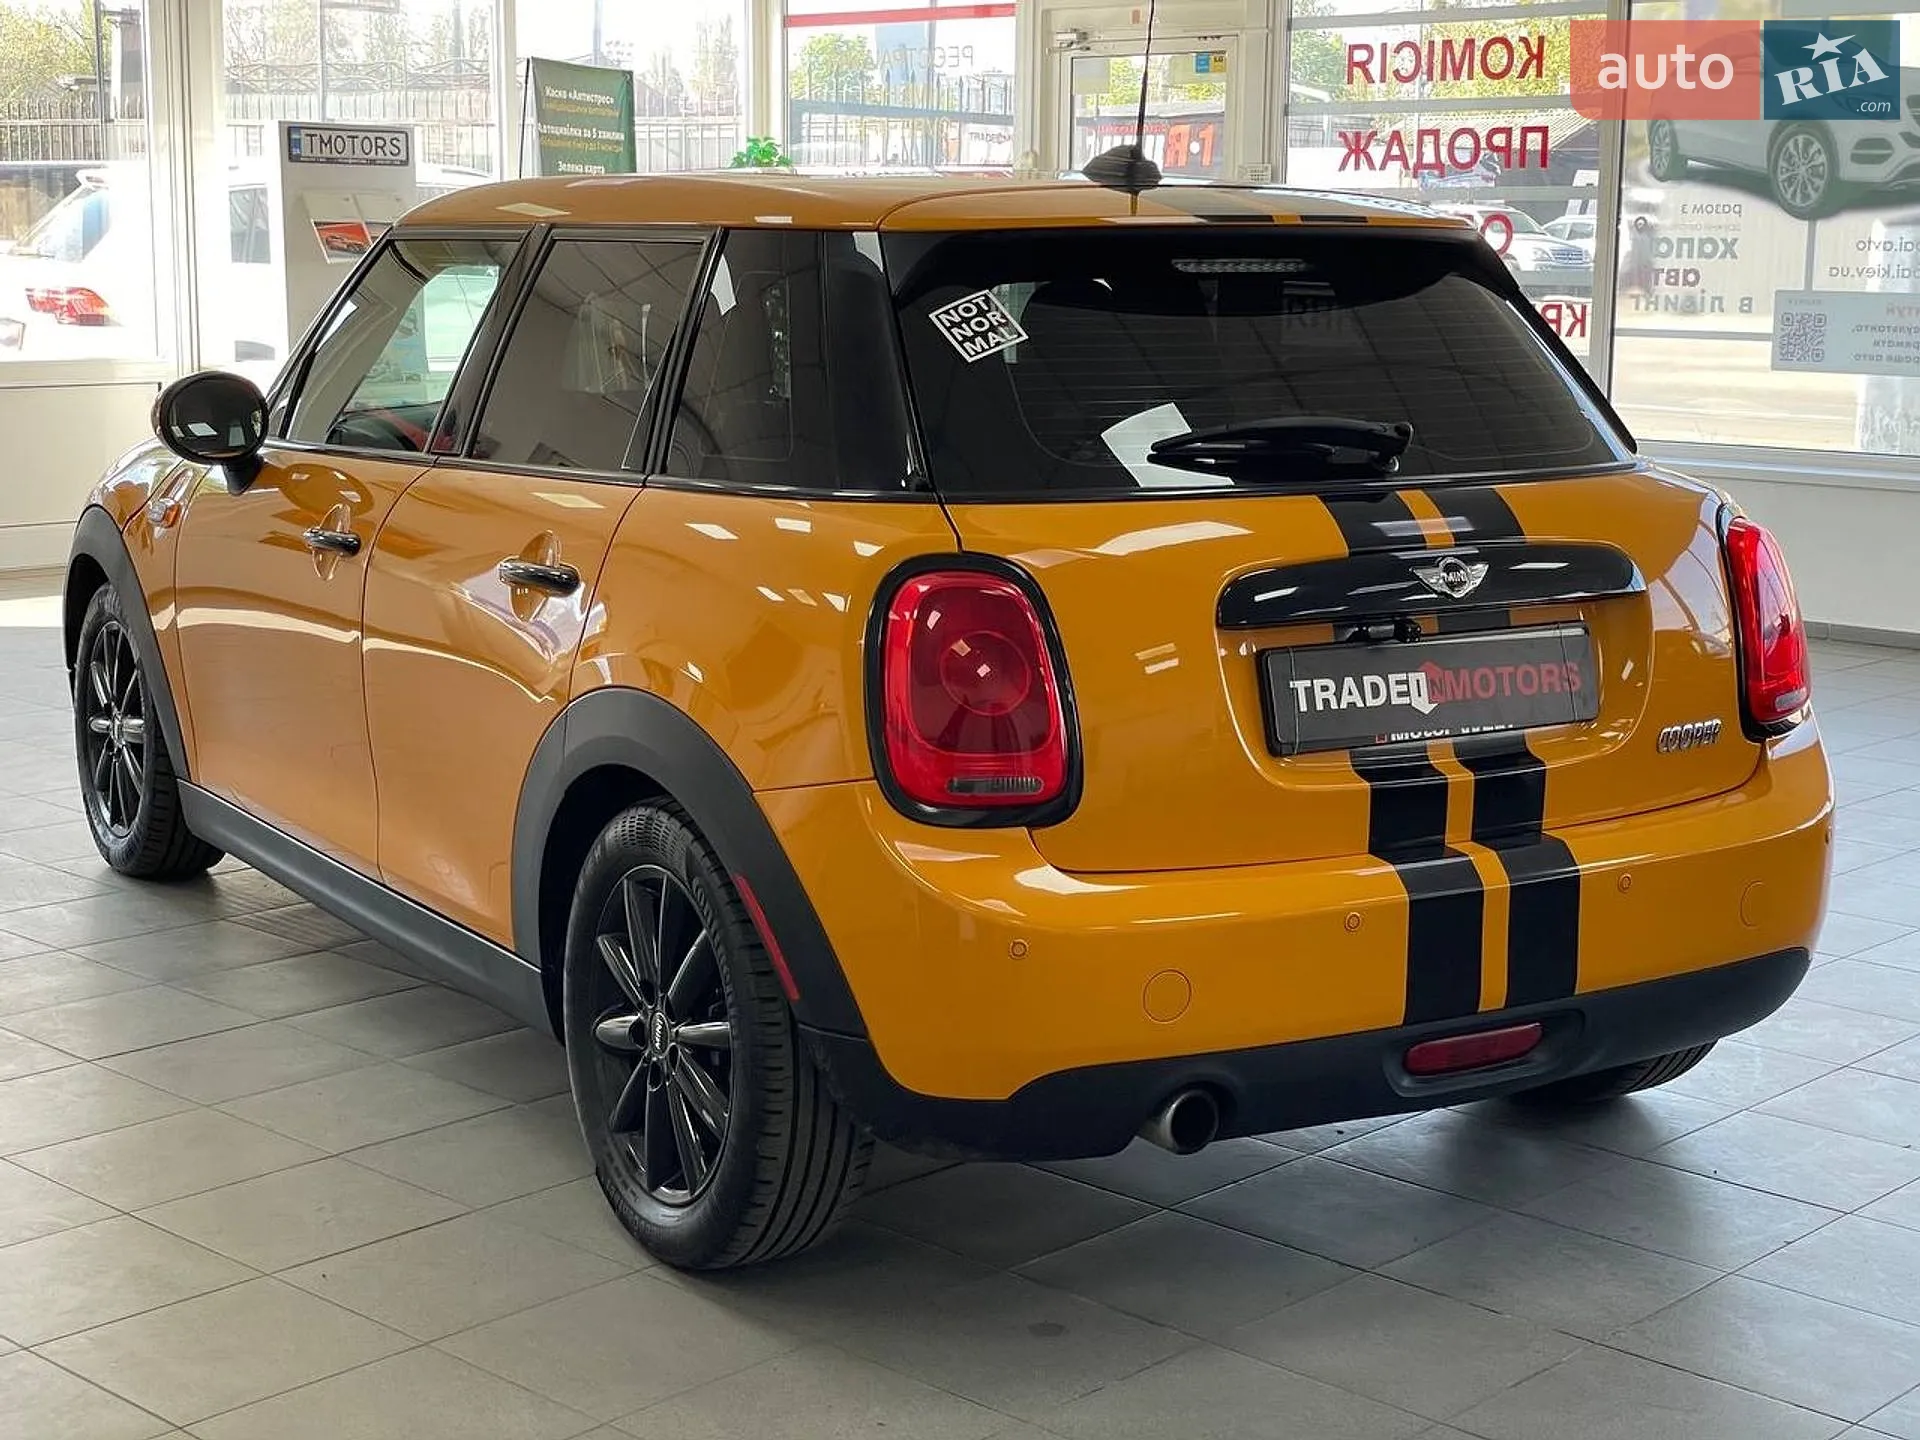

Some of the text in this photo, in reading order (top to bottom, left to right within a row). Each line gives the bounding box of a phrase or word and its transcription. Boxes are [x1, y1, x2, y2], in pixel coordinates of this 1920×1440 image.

[305, 133, 401, 157] TMOTORS
[938, 295, 989, 327] NOT
[951, 310, 1006, 341] NOR
[963, 326, 1018, 355] MAL
[1657, 718, 1722, 753] COOPER
